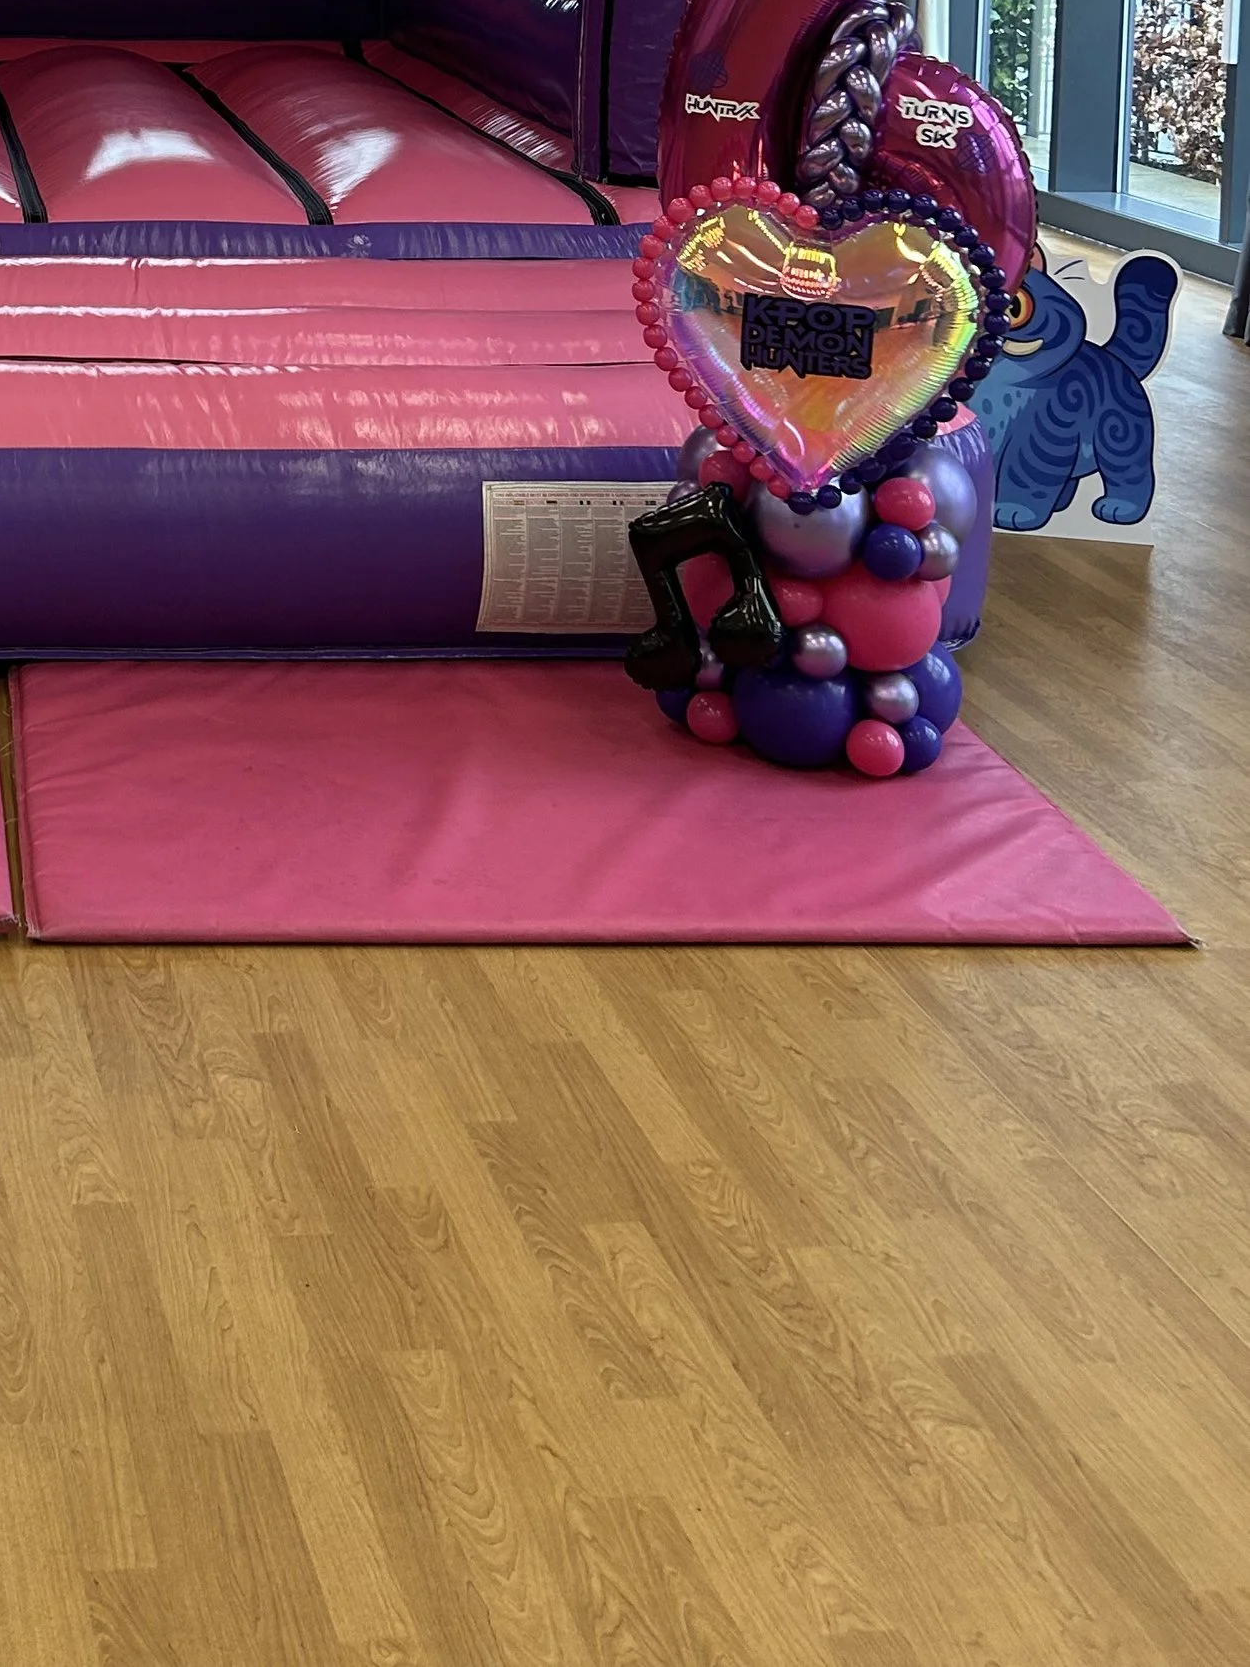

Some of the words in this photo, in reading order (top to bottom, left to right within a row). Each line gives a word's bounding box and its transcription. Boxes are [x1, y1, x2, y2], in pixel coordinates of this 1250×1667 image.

[903, 100, 969, 125] TURNS
[921, 128, 953, 146] SIX
[745, 324, 871, 358] DEMON
[744, 343, 871, 377] HUNTERS
